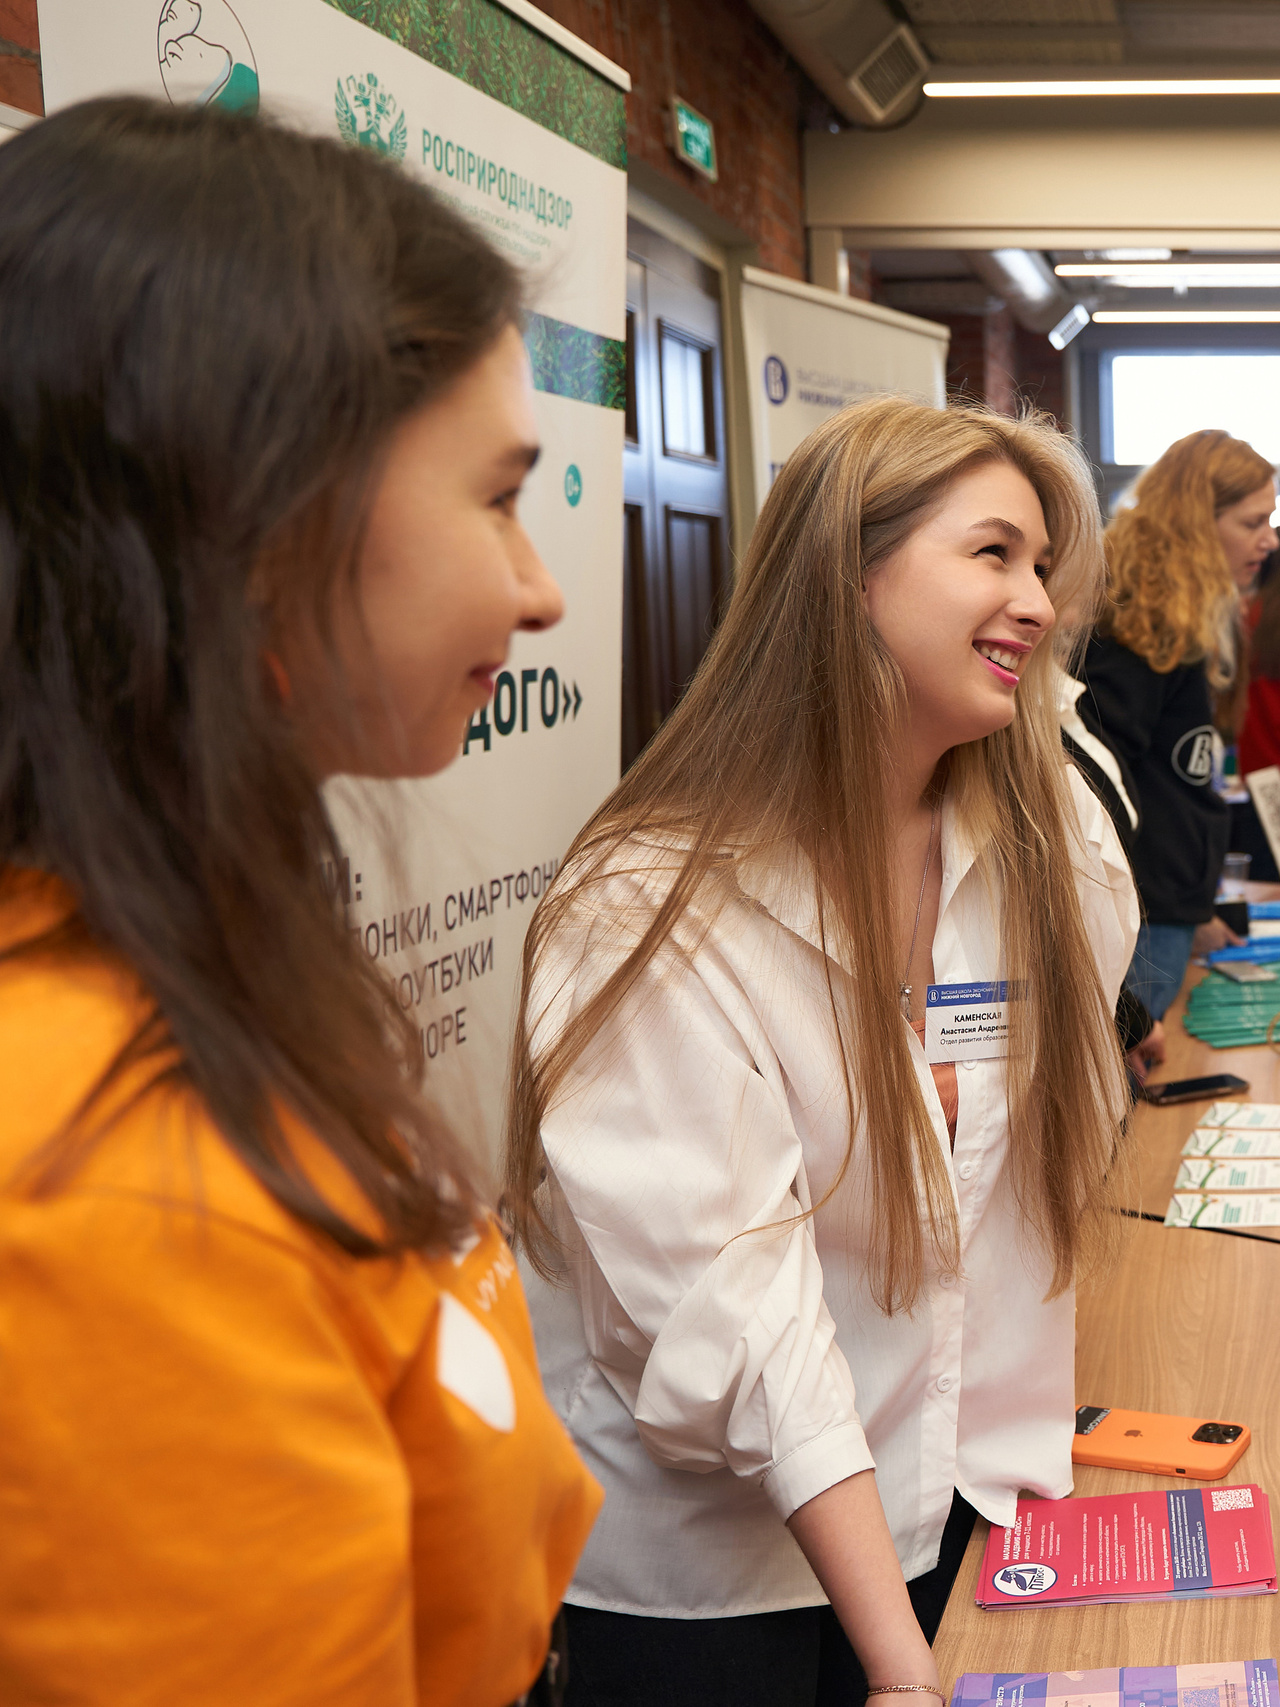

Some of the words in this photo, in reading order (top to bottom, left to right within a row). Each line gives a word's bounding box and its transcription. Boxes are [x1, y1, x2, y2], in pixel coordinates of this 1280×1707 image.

[423, 128, 573, 230] РОСПРИРОДНАДЗОР
[954, 1012, 1002, 1023] КАМЕНСКАЯ
[940, 1027, 977, 1036] Анастасия
